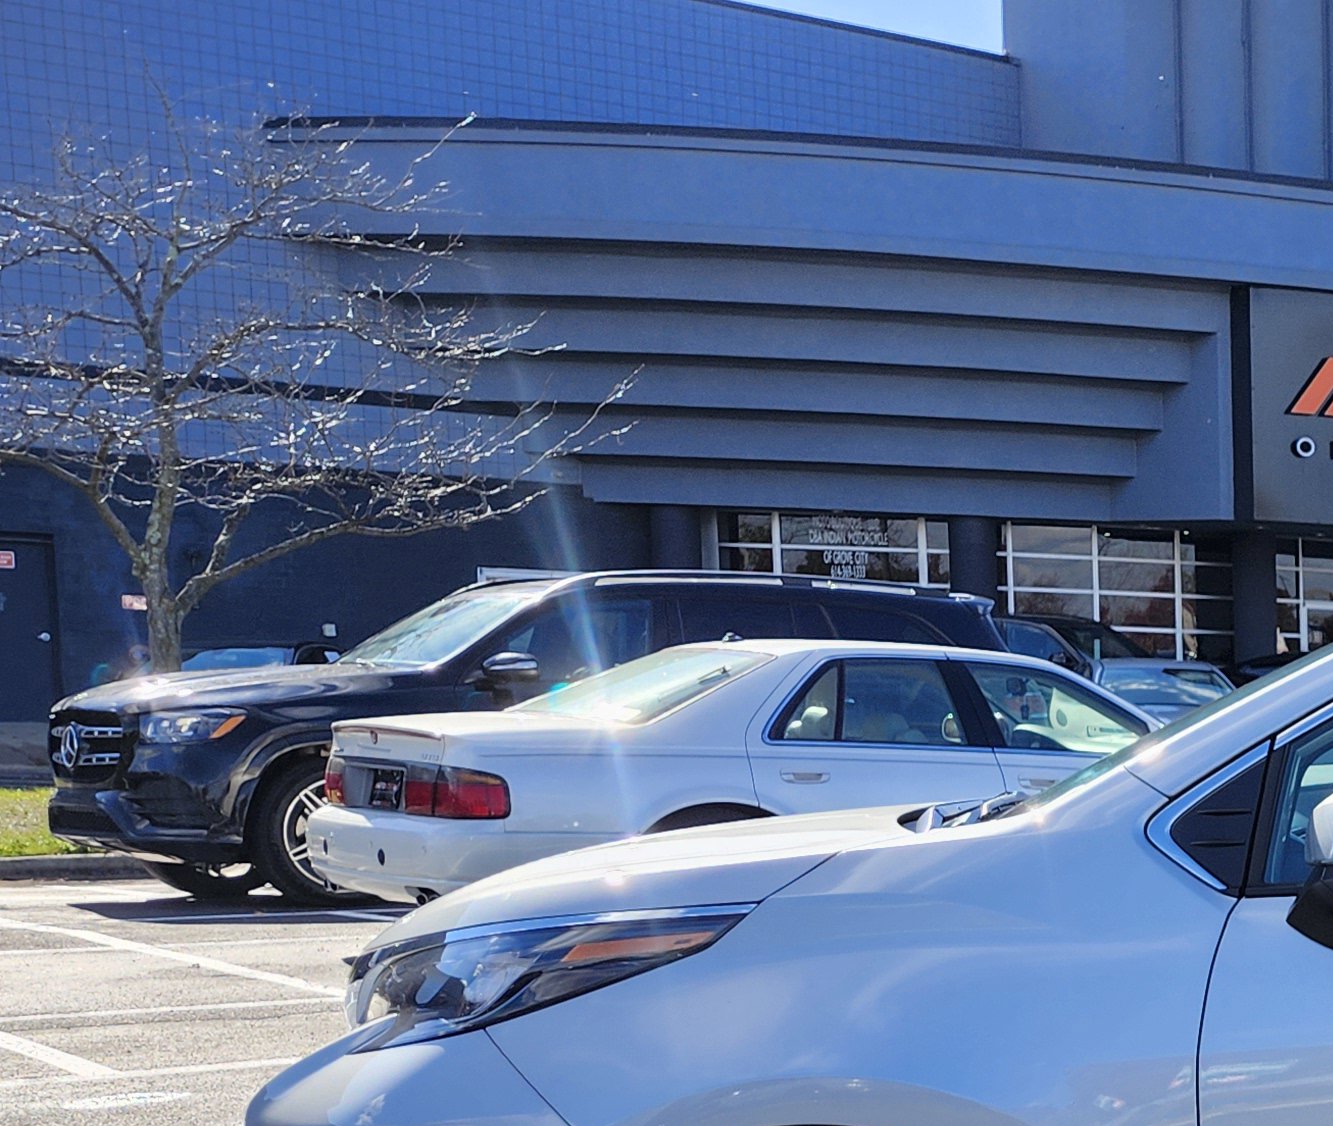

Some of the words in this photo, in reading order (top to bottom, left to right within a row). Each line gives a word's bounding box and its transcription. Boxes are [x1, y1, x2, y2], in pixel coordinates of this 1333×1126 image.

[823, 550, 832, 564] OF
[833, 551, 854, 565] GROVE
[855, 551, 869, 565] CITY
